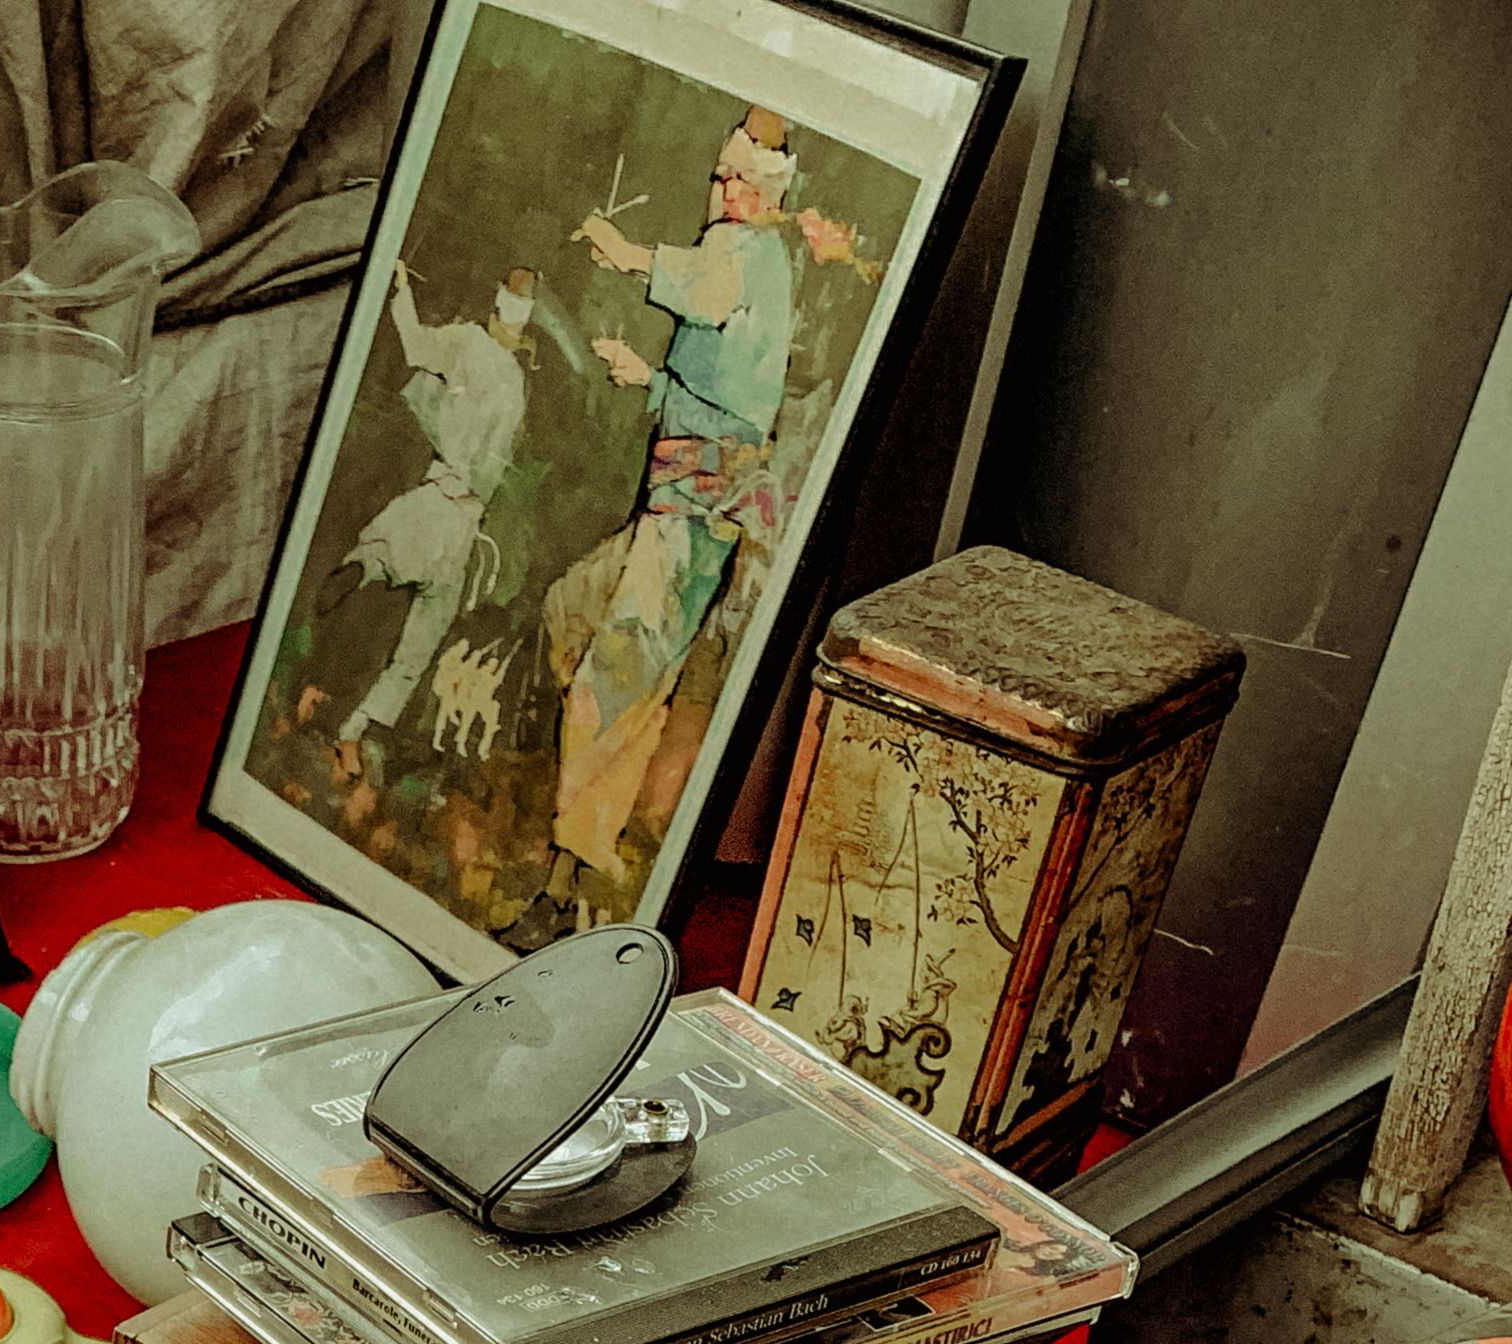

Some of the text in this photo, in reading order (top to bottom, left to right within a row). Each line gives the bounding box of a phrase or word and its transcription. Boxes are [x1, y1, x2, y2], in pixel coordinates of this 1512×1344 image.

[715, 1164, 829, 1206] Johann
[238, 1196, 326, 1269] CHOPIN
[920, 1249, 981, 1277] CD 160 134
[789, 1295, 828, 1321] Bach
